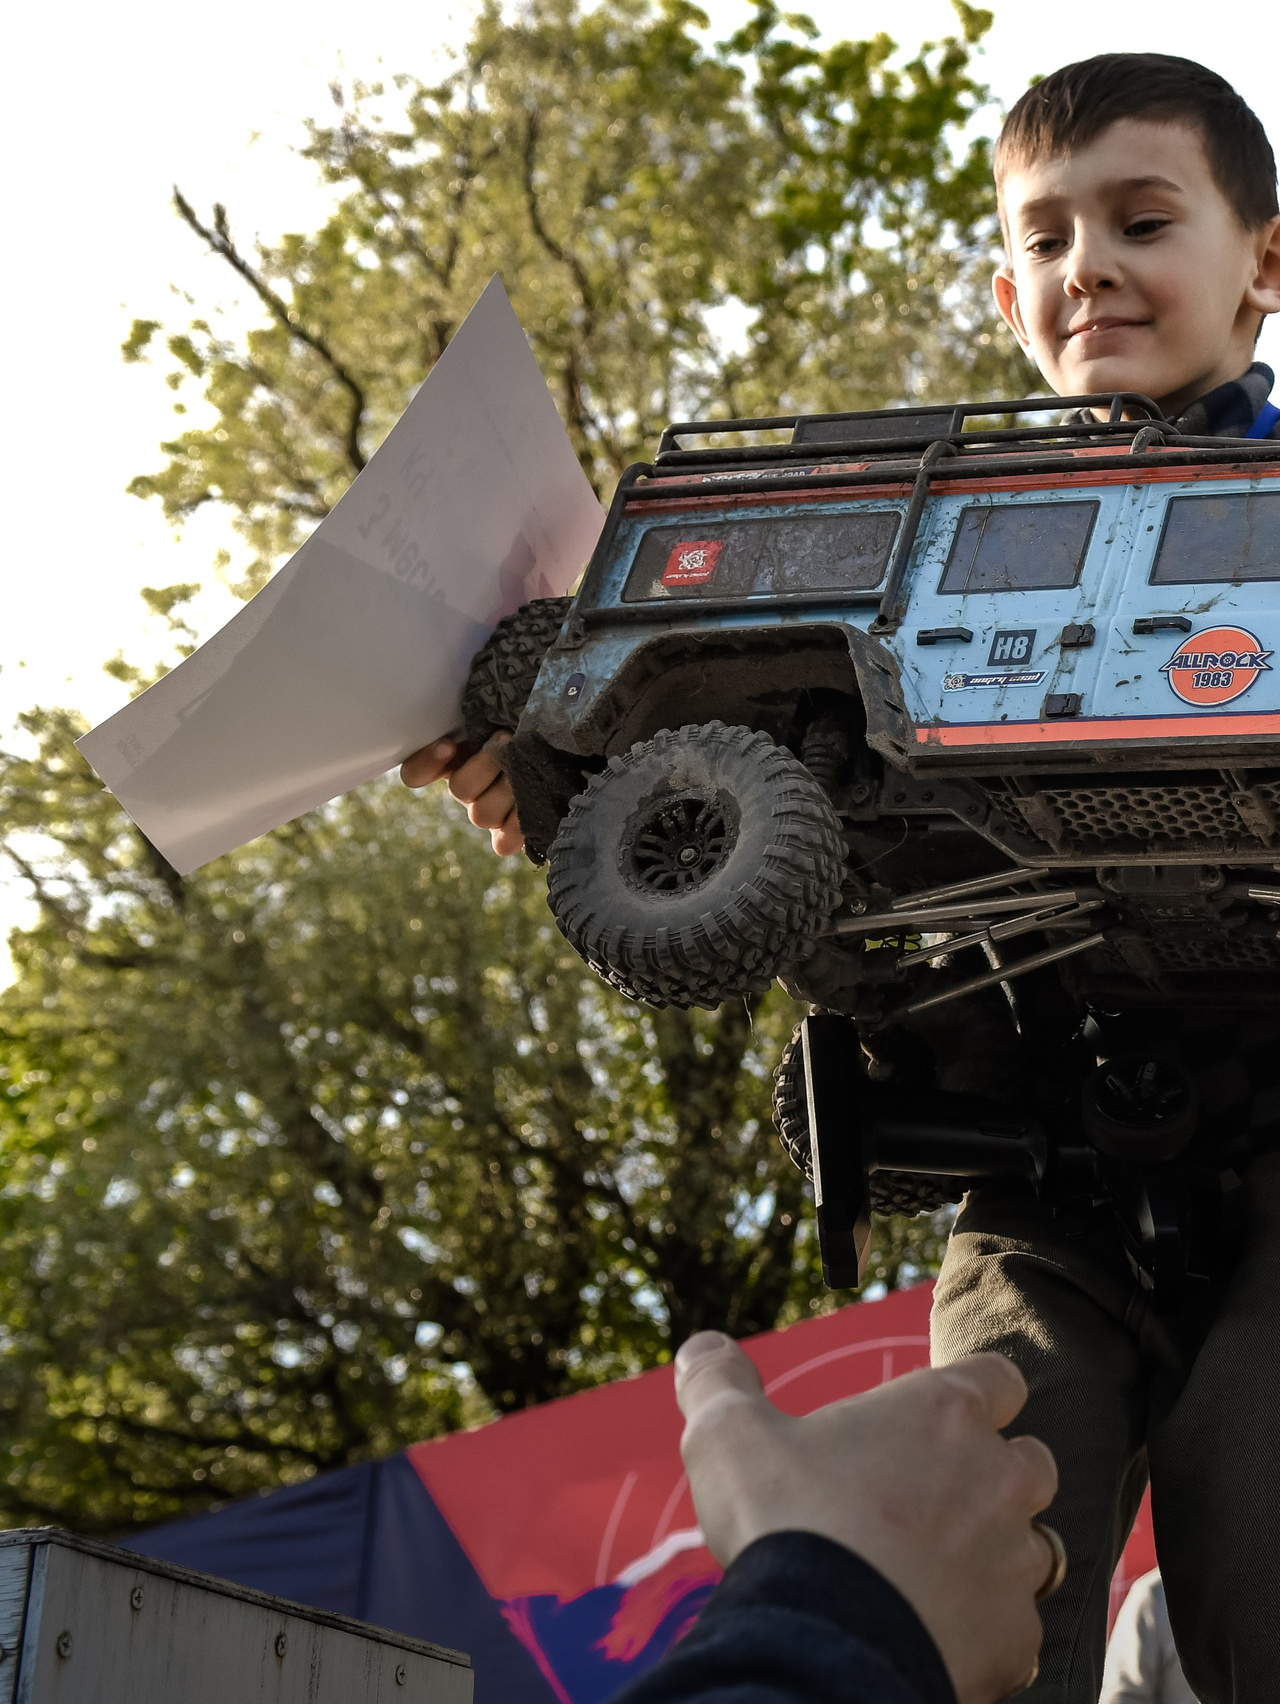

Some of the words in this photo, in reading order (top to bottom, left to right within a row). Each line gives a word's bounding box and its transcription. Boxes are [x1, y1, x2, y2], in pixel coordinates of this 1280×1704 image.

[993, 636, 1029, 660] H8
[1160, 650, 1272, 670] ALLROCK
[1192, 671, 1233, 689] 1983
